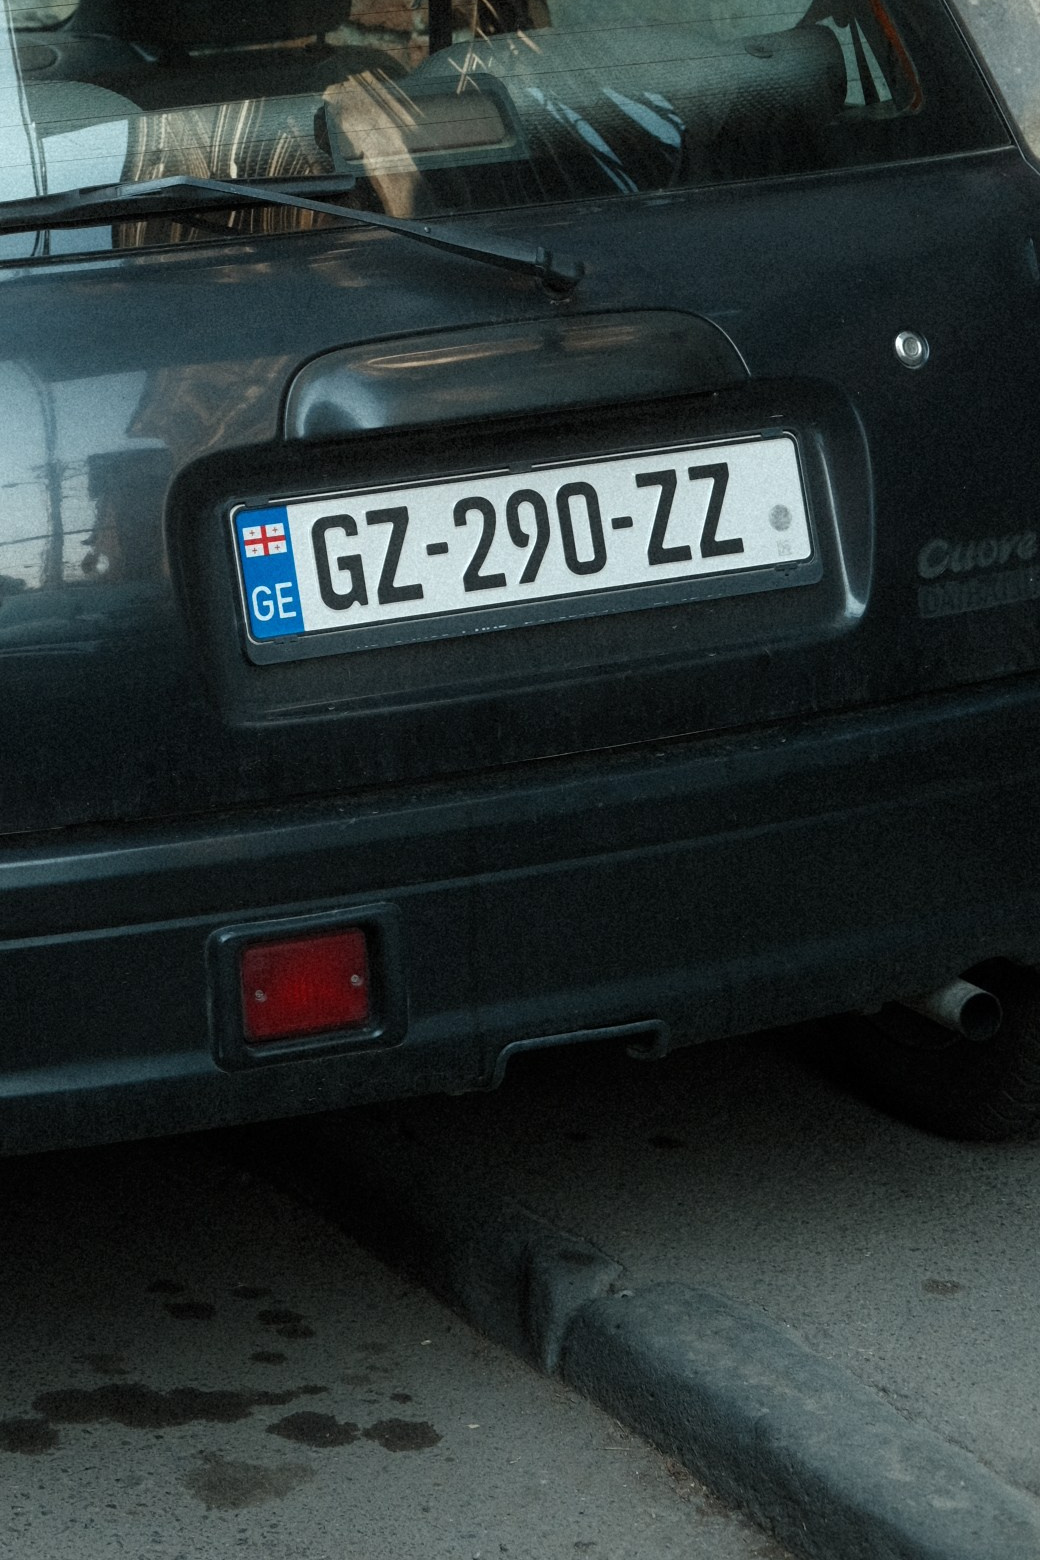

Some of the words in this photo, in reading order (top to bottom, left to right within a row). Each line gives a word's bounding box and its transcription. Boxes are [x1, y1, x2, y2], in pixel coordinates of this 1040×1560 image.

[311, 461, 745, 611] GZ-290-ZZ
[917, 531, 1038, 579] Cuore
[251, 581, 297, 622] GE
